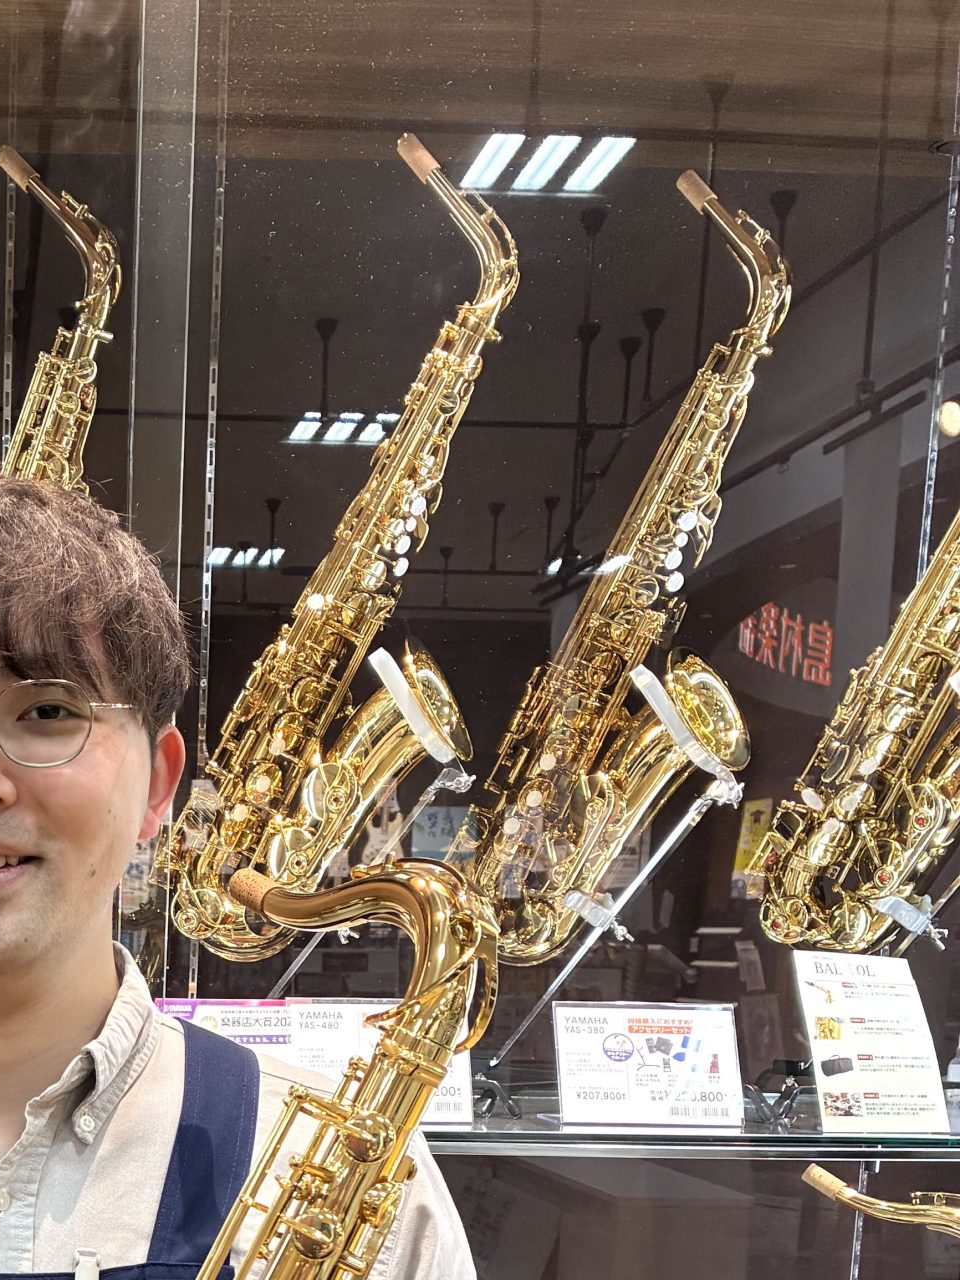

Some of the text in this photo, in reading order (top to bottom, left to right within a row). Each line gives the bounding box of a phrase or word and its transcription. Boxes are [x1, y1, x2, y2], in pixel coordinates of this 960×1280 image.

[299, 1011, 343, 1020] YAMAHA
[564, 1016, 609, 1025] YAMAHA
[299, 1021, 340, 1030] YAS-480
[565, 1026, 605, 1035] YAS-380
